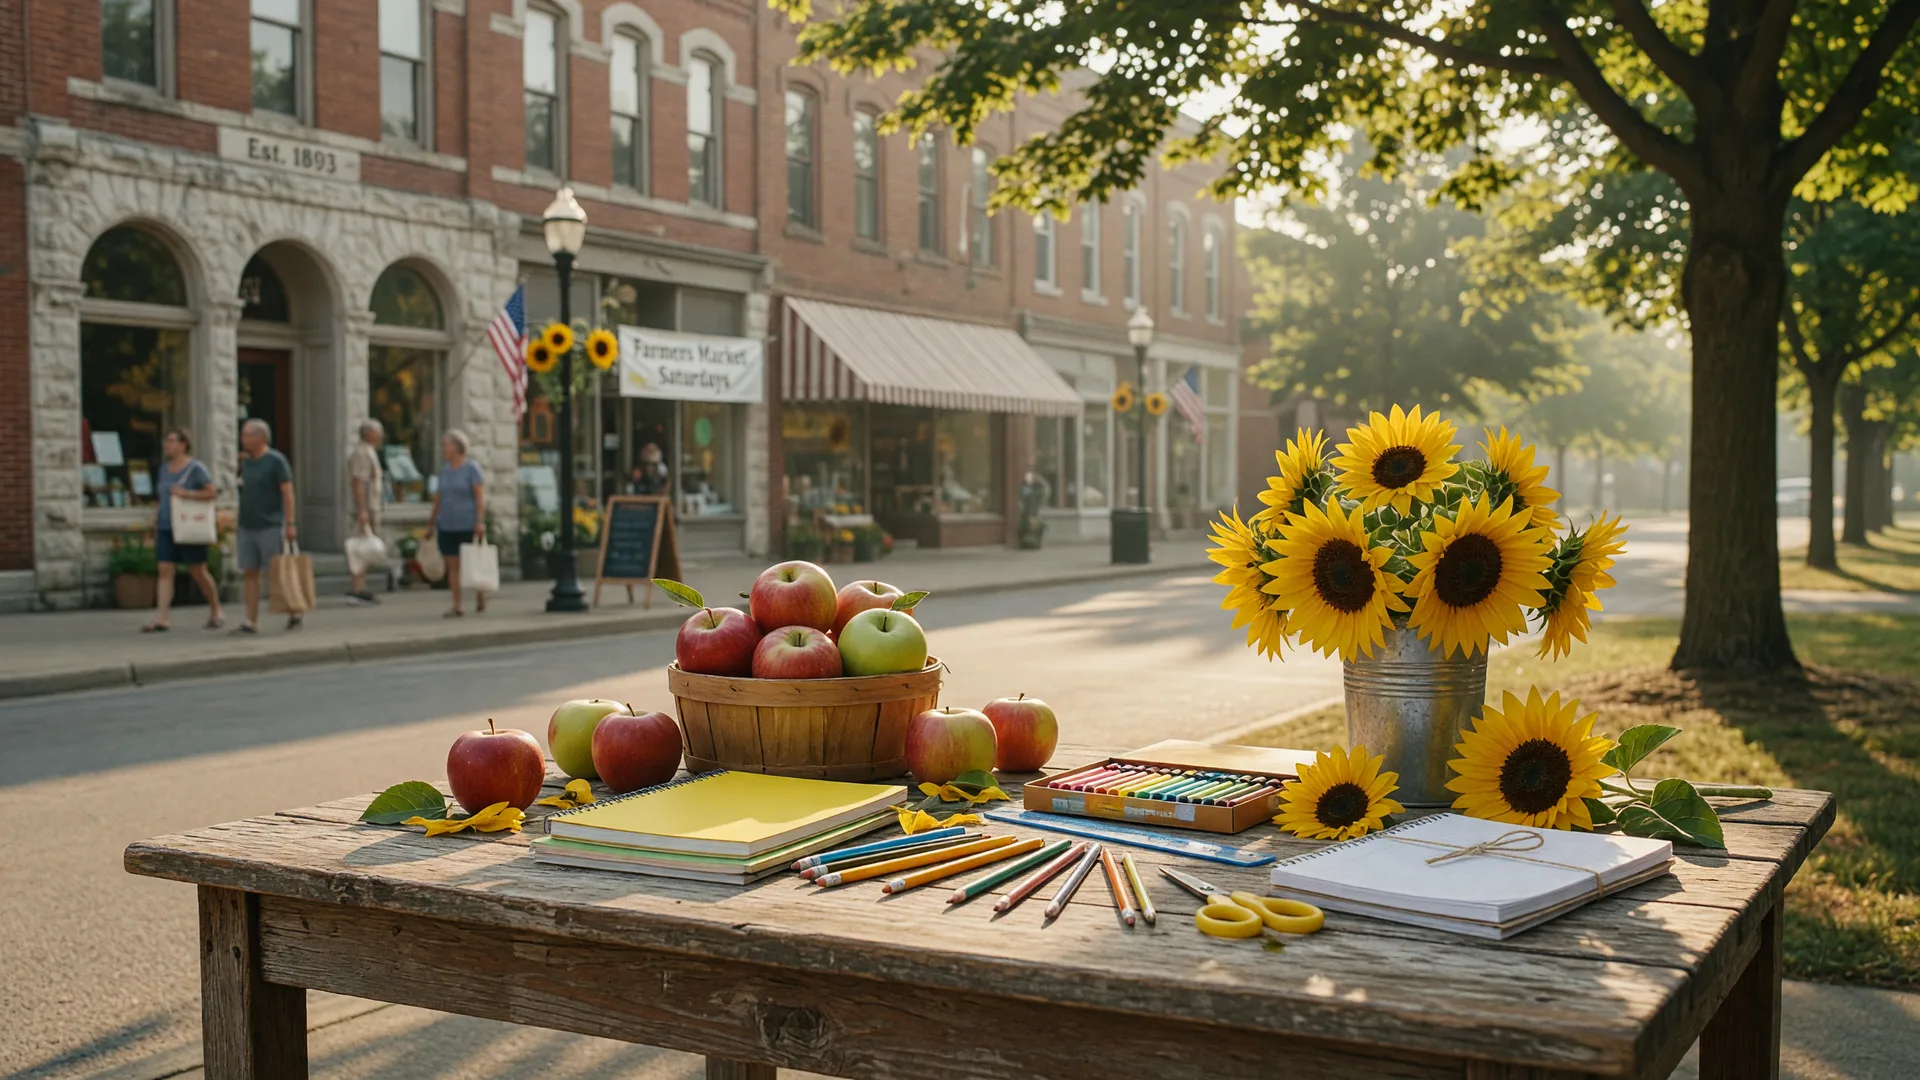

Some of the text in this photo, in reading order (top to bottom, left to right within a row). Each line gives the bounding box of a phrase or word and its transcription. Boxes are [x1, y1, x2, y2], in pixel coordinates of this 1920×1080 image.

[248, 138, 336, 173] Est. 1893
[633, 338, 747, 365] Farmers Market
[658, 366, 729, 394] Saturdays
